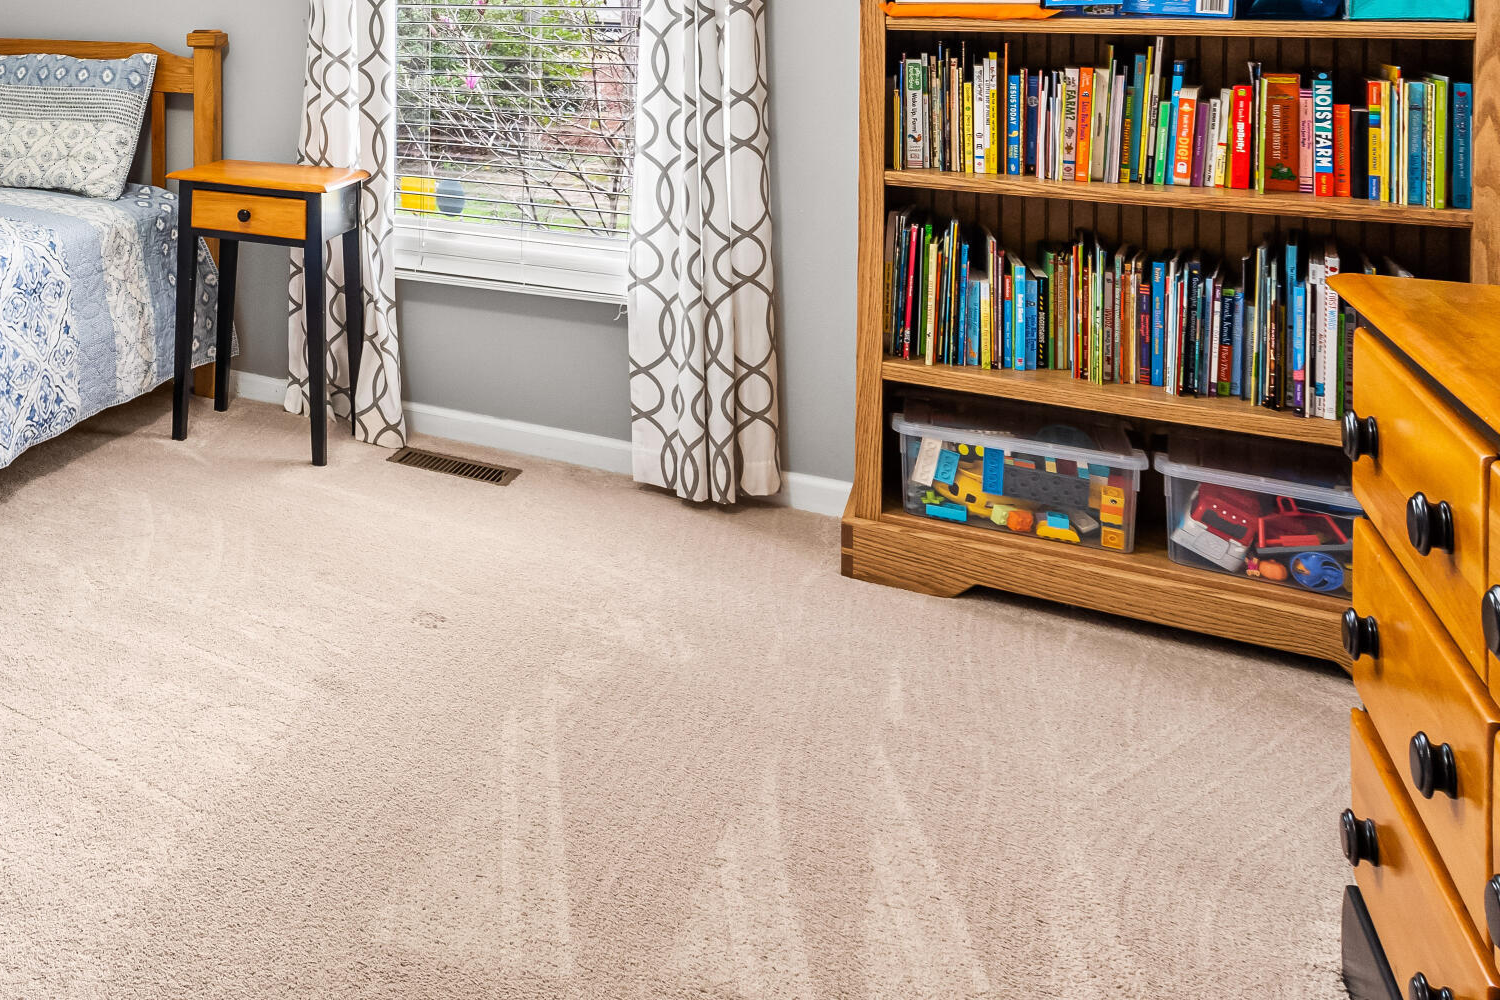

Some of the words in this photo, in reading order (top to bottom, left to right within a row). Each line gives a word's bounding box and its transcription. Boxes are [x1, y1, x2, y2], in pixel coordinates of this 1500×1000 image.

[1065, 90, 1076, 121] FARM?
[1315, 85, 1332, 128] NOISY
[1178, 137, 1190, 160] DIG!
[1315, 131, 1332, 167] FARM
[1223, 297, 1233, 320] Knock,
[1327, 310, 1337, 330] WORDS
[1222, 321, 1231, 345] Knock!
[1220, 345, 1230, 362] Who's
[1220, 363, 1229, 381] There?
